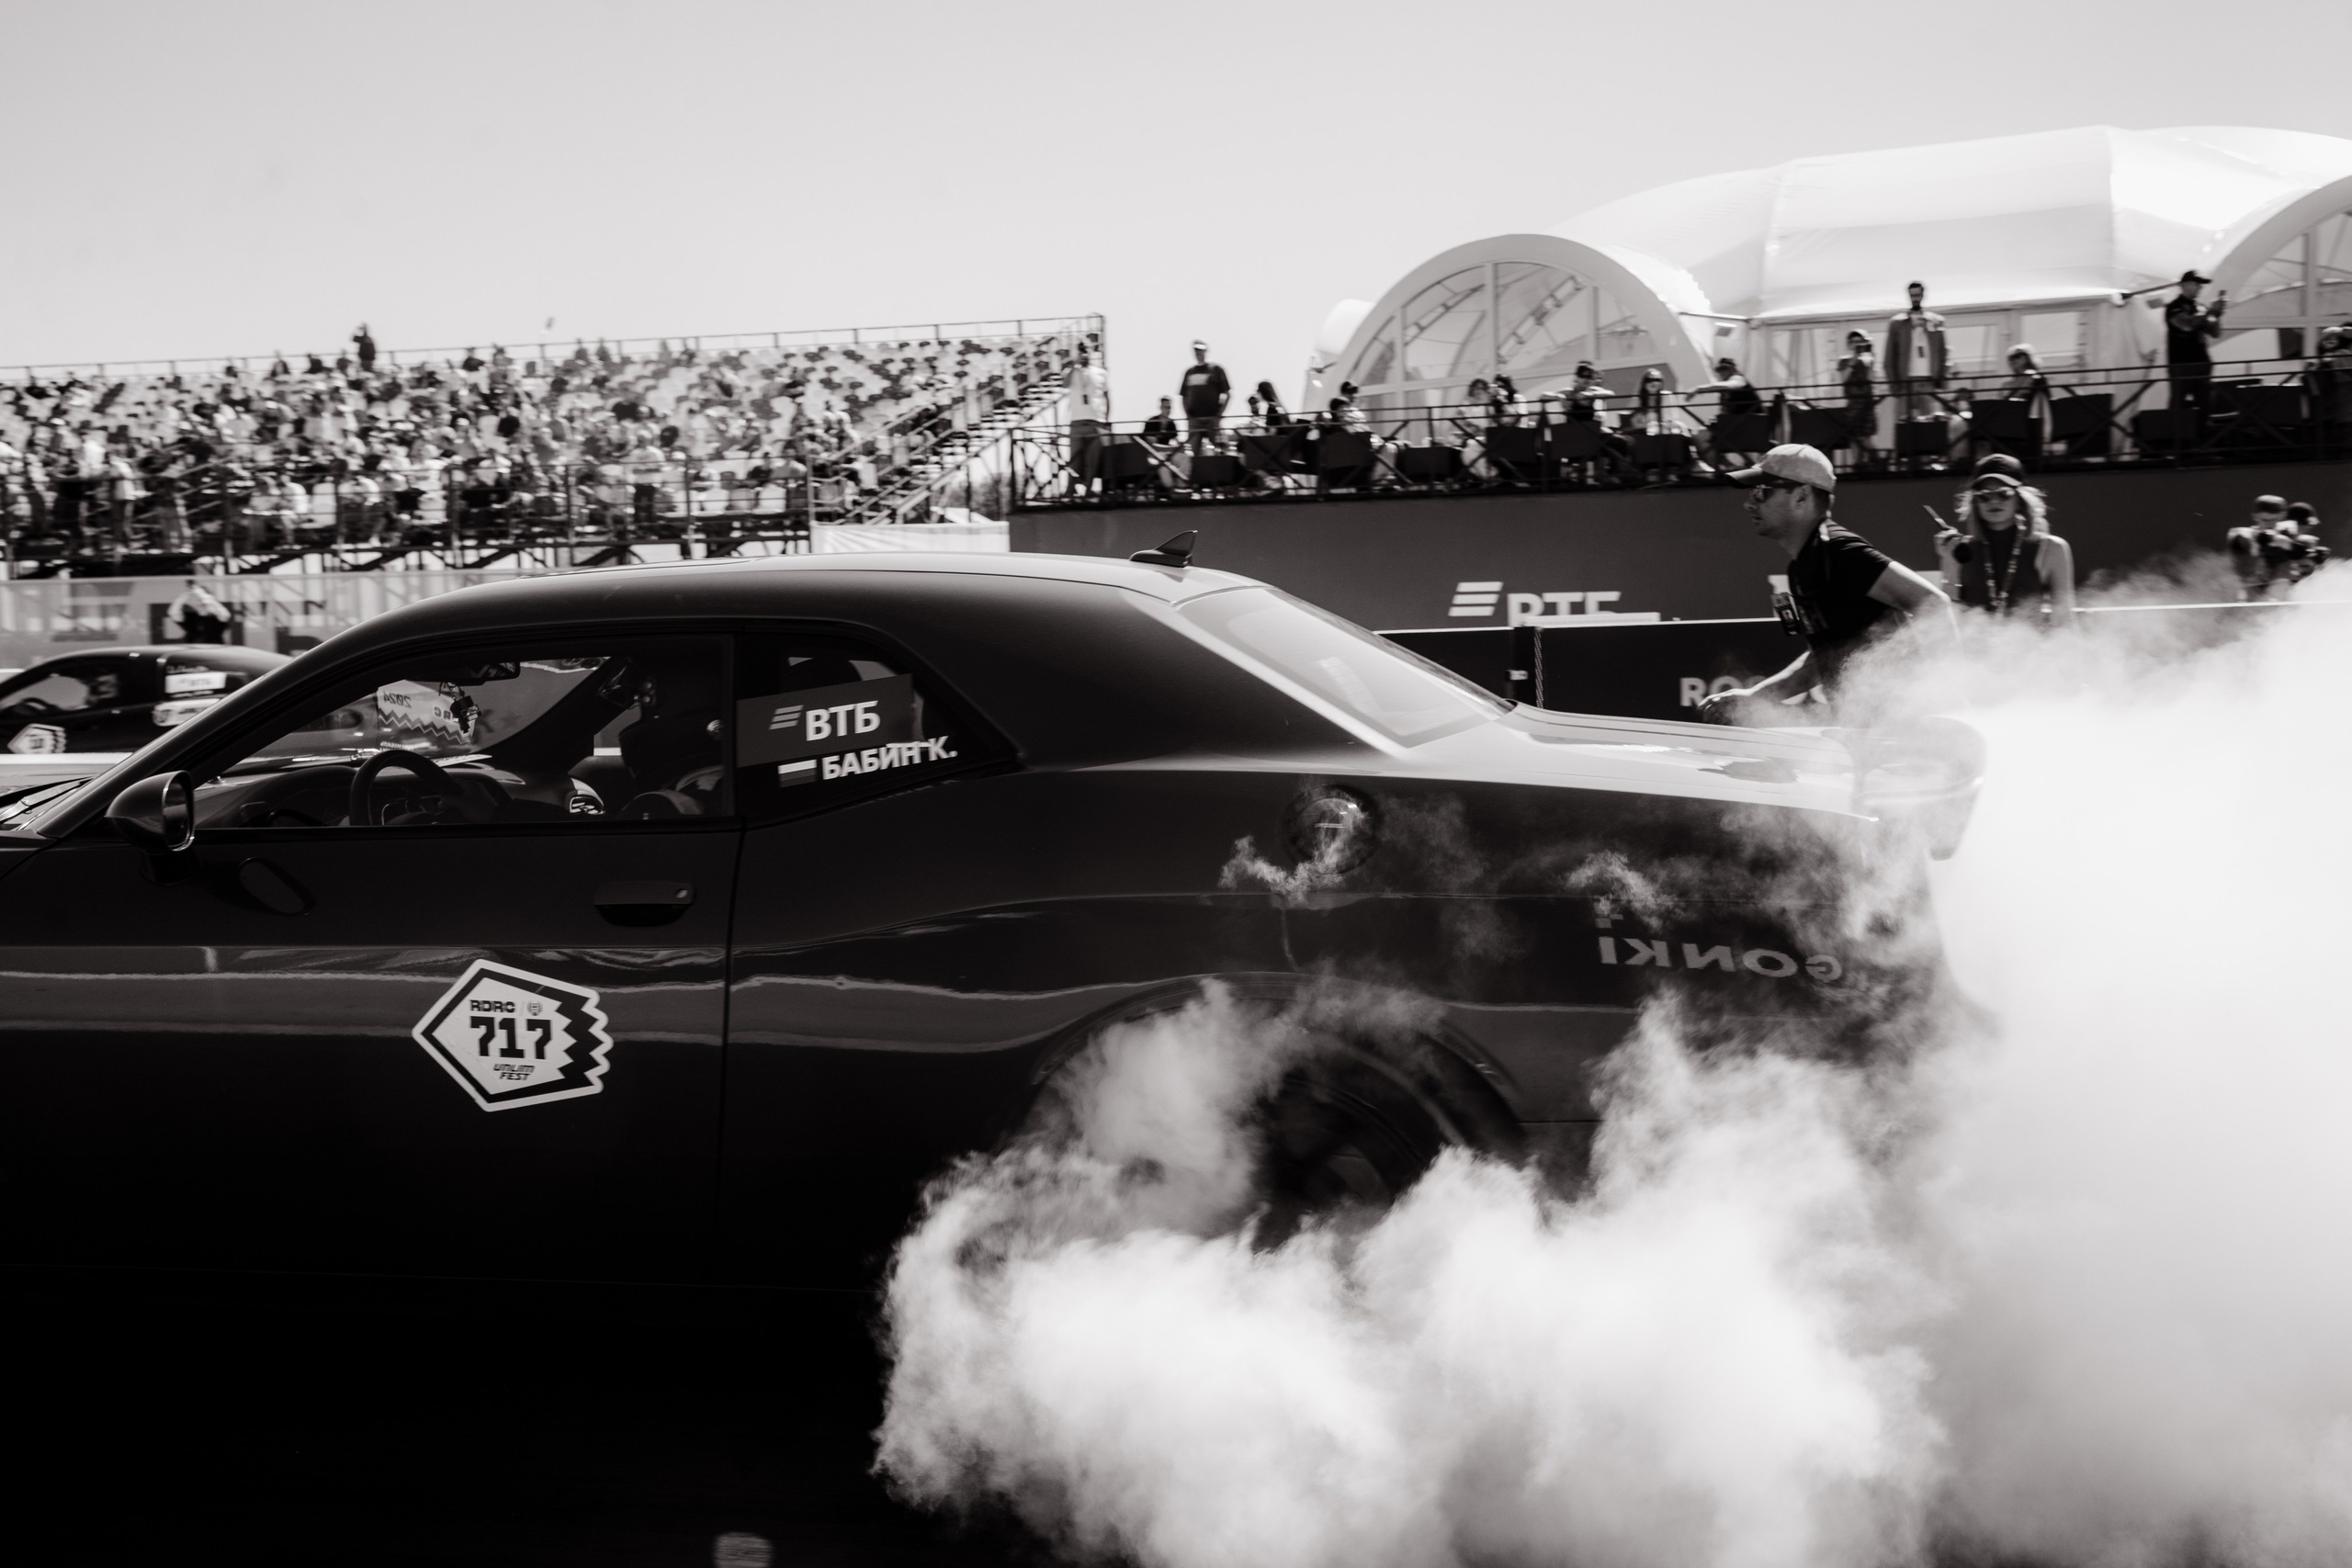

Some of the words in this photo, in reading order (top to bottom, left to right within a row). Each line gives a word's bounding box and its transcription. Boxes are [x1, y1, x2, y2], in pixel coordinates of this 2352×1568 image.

[806, 700, 881, 741] ВТБ
[821, 742, 922, 780] БАБИН
[469, 1016, 553, 1060] 717
[499, 1072, 530, 1081] FEST
